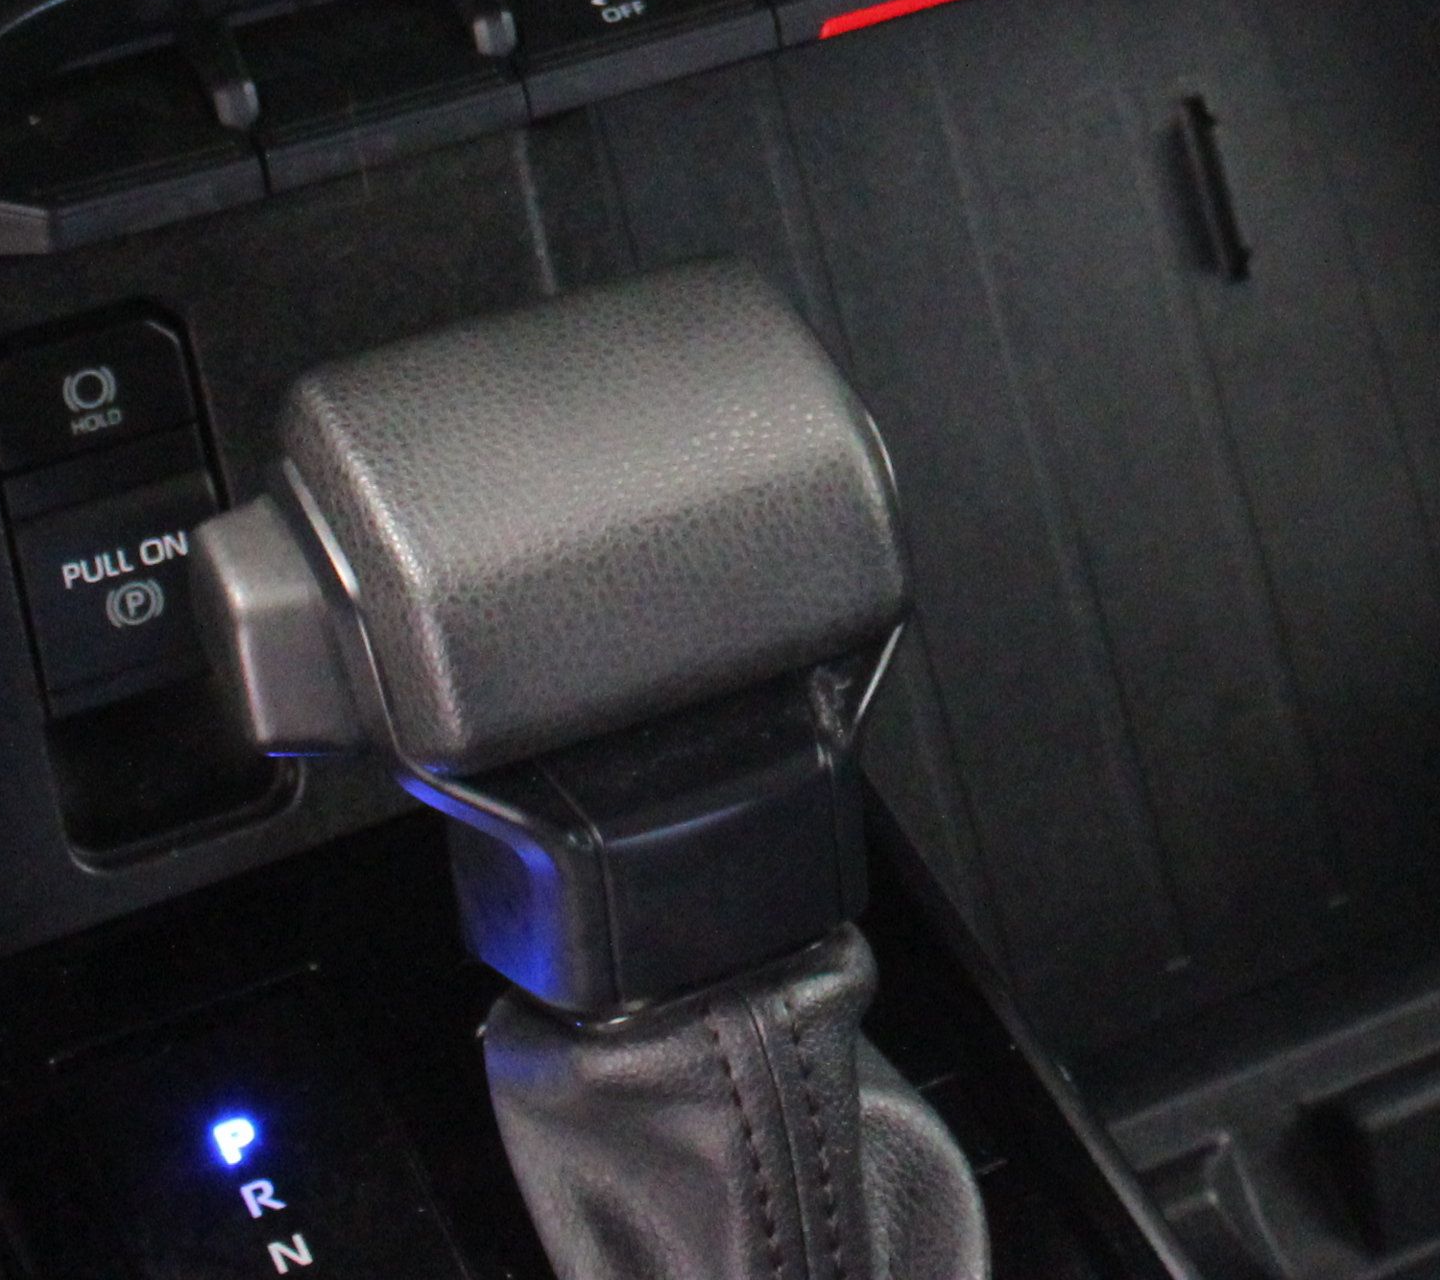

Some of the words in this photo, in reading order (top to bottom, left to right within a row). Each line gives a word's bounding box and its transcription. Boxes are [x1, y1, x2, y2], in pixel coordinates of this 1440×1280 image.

[71, 408, 123, 436] HOLD
[61, 548, 134, 590] PULL
[139, 530, 189, 567] ON
[212, 1116, 256, 1166] P
[239, 1177, 287, 1219] R
[267, 1232, 313, 1276] N
